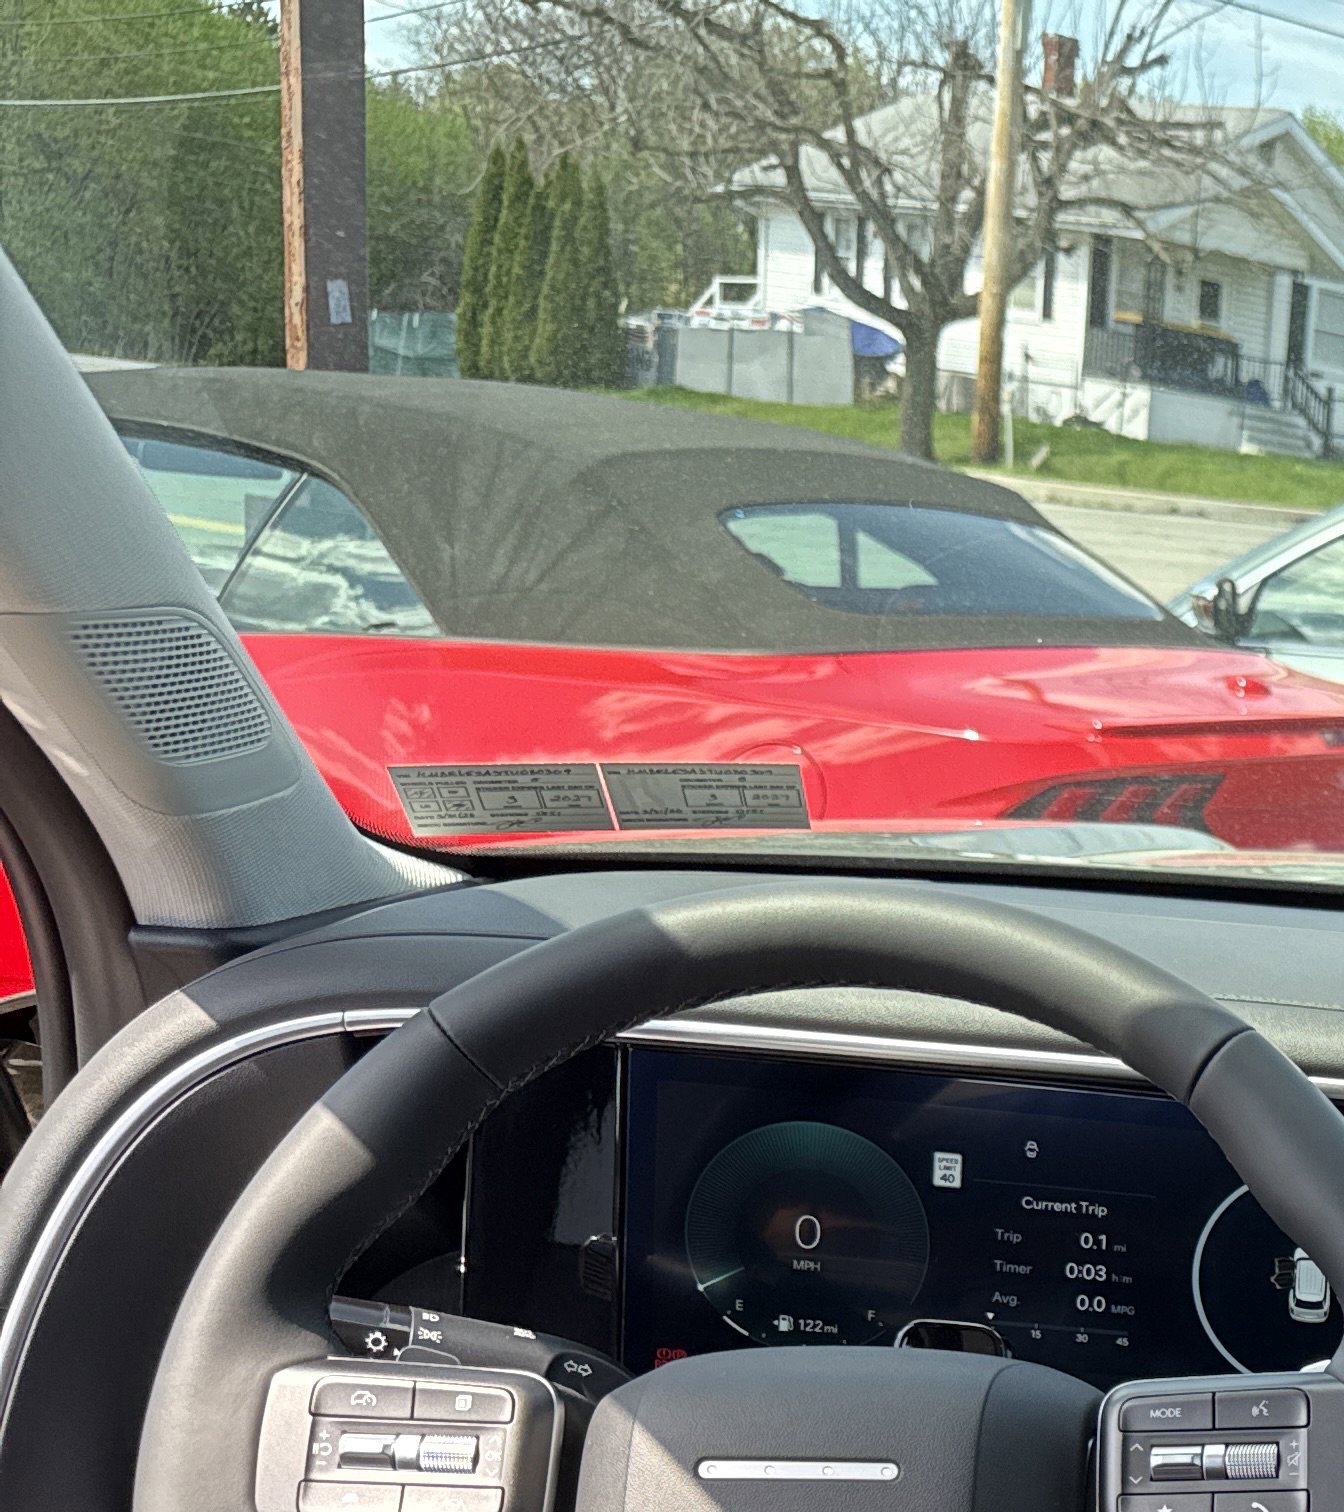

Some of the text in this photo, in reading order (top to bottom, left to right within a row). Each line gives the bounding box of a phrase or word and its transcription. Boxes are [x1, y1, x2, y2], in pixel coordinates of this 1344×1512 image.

[940, 1173, 955, 1183] 40
[1021, 1196, 1108, 1218] Current Trip
[795, 1215, 820, 1249] 0
[995, 1228, 1127, 1252] Trip 0.1 mi
[793, 1259, 821, 1272] MPH
[994, 1260, 1033, 1275] Timer
[1065, 1262, 1107, 1281] 0:03
[735, 1299, 744, 1311] E
[992, 1291, 1135, 1316] Avg. 0.0 MPG
[867, 1310, 876, 1321] F
[1031, 1329, 1129, 1347] 15 30 45
[1150, 1407, 1182, 1419] MODE
